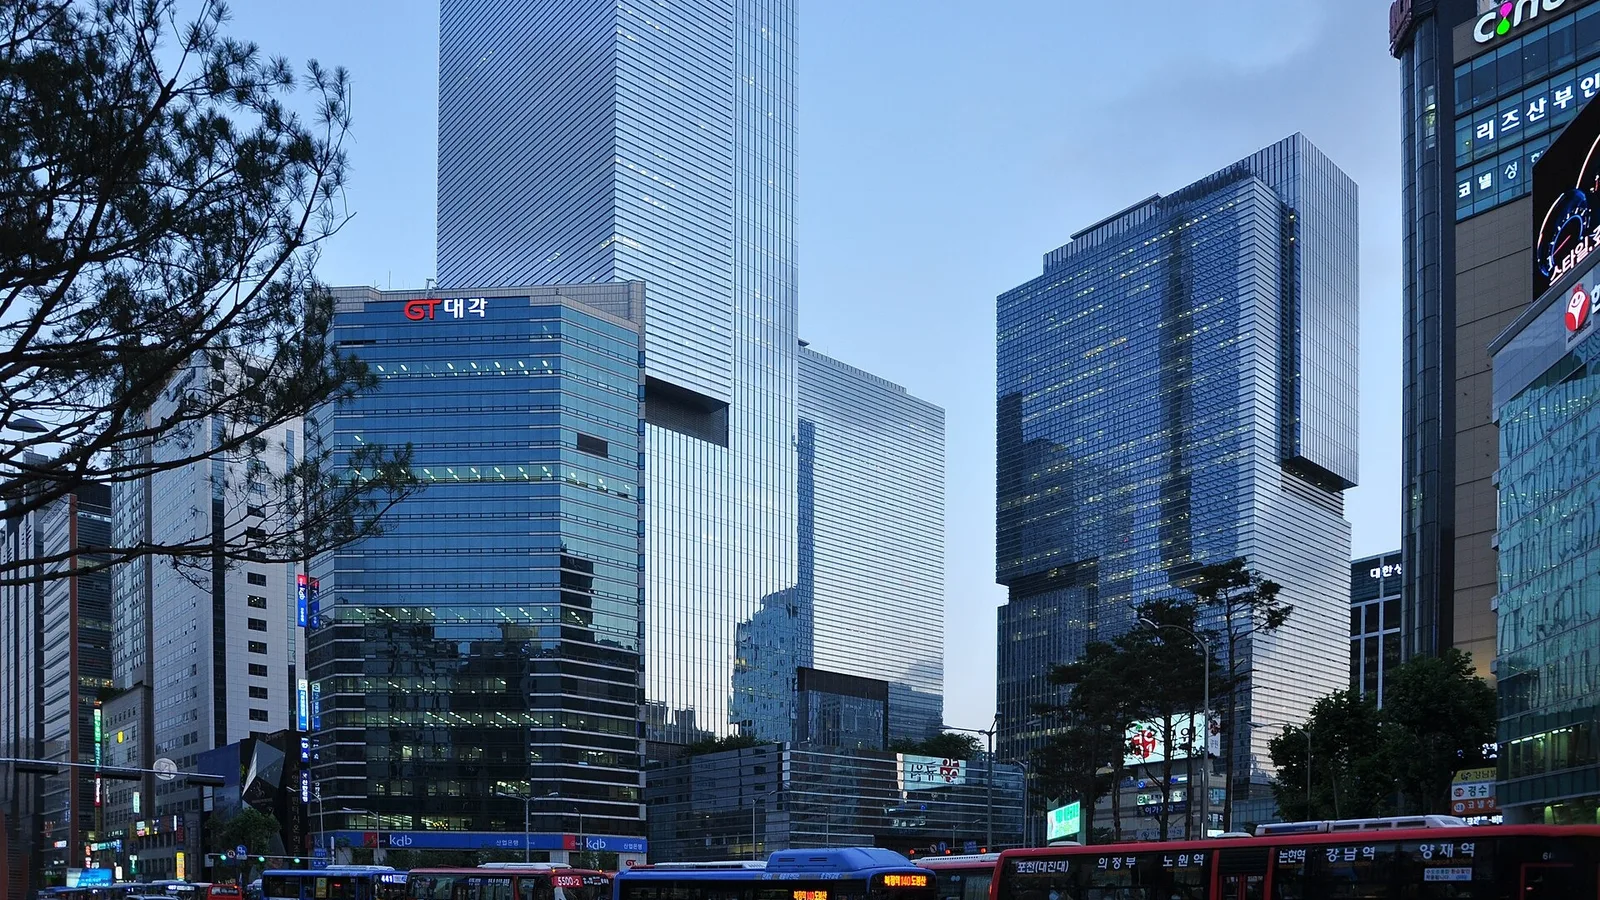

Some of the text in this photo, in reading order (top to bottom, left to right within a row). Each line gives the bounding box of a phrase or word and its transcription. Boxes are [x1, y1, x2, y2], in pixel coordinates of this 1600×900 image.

[404, 297, 488, 320] GT 대각
[389, 834, 413, 847] kdb
[586, 838, 607, 850] kdb
[1279, 849, 1306, 864] 논현역
[1326, 846, 1375, 862] 강남역
[1419, 842, 1475, 860] 양재역
[1098, 857, 1136, 870] 의정부
[1163, 854, 1204, 867] 노원역
[381, 875, 393, 883] 441
[557, 876, 580, 886] 5500-2
[901, 875, 911, 886] 140
